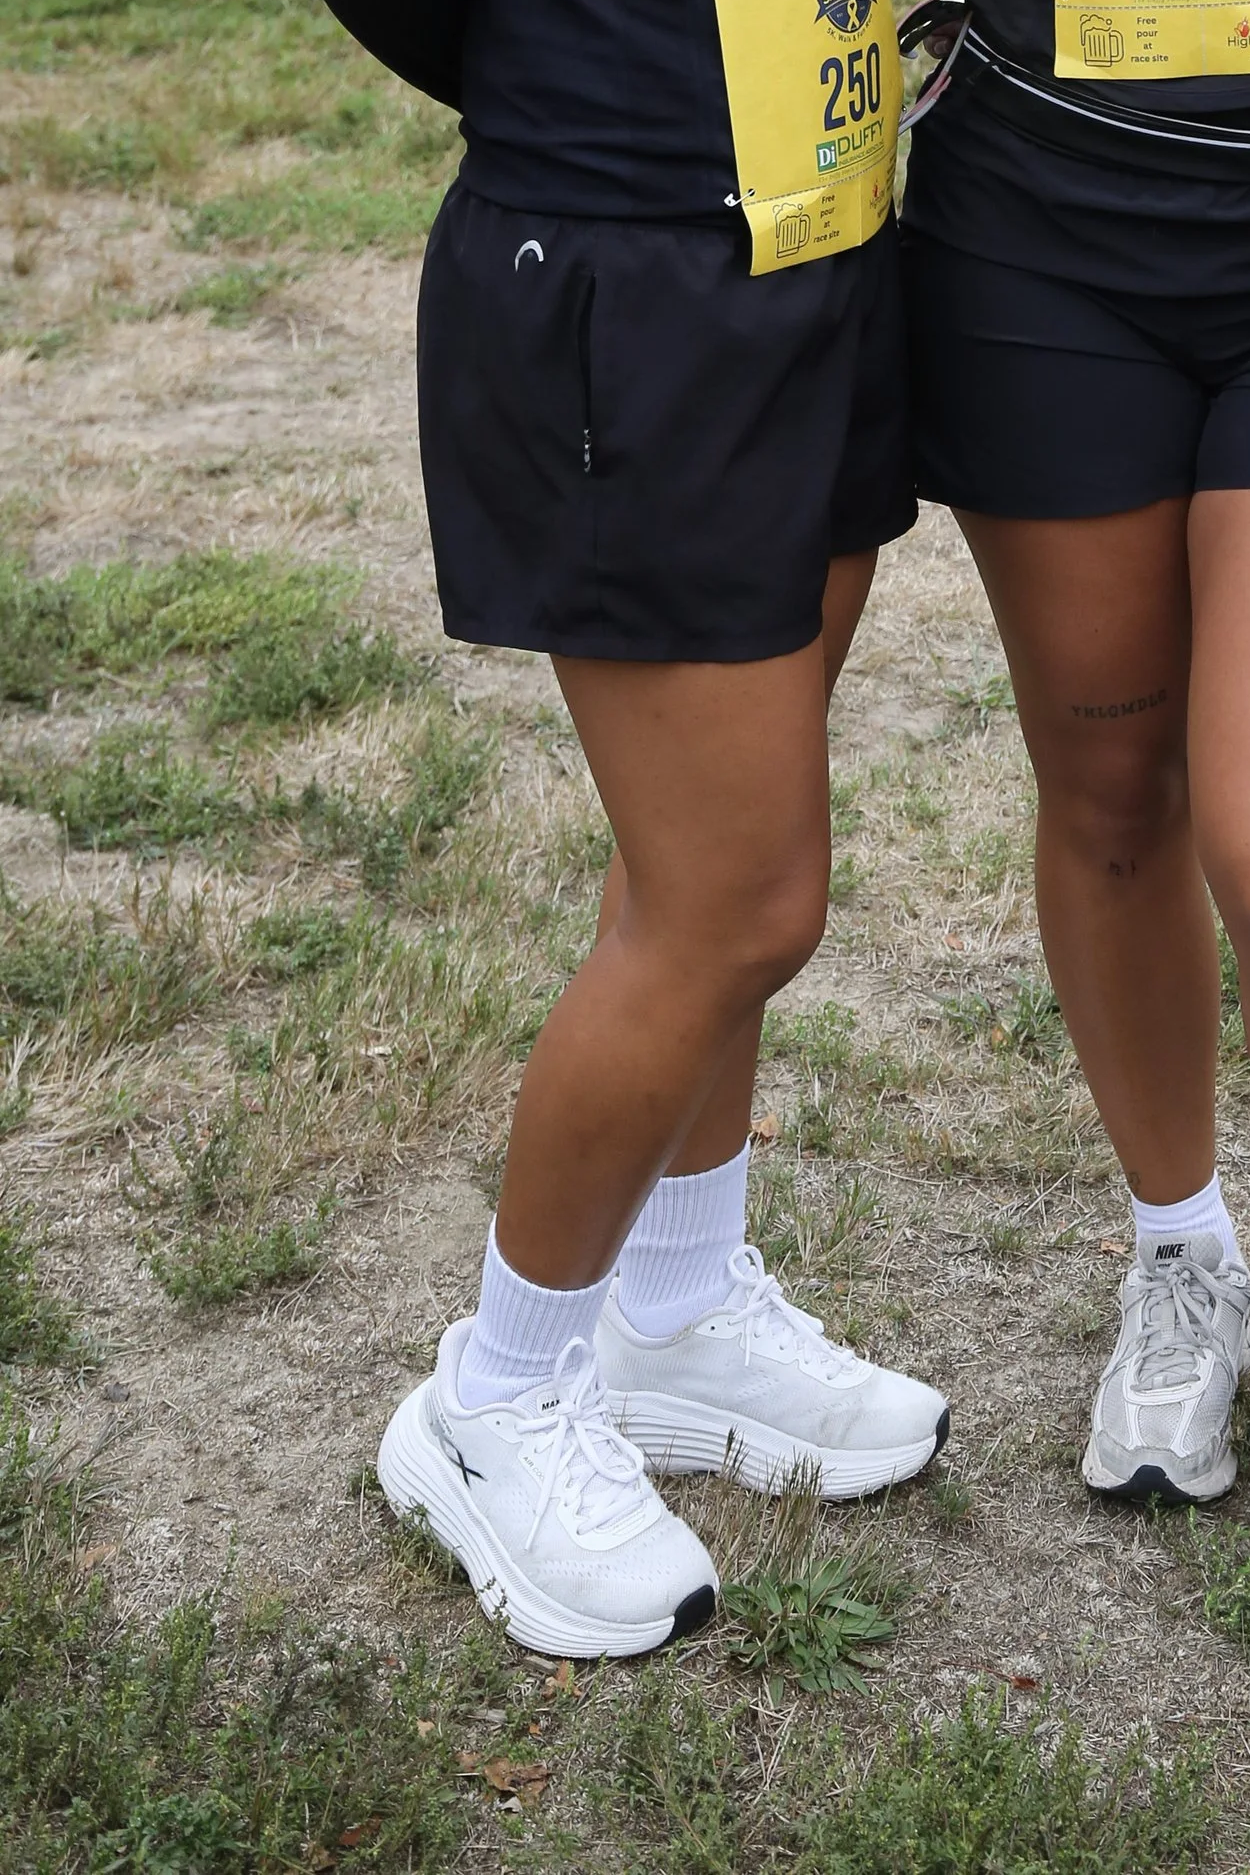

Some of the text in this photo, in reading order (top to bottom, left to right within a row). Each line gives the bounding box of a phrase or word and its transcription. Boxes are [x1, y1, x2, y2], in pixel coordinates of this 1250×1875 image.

[1136, 17, 1157, 25] Free
[1136, 30, 1158, 40] pour
[1143, 42, 1153, 50] at
[1152, 54, 1169, 62] site
[819, 42, 881, 132] 250
[817, 145, 837, 167] Di
[837, 116, 885, 157] DUFFY
[821, 194, 835, 204] Free
[820, 207, 835, 219] pour
[823, 220, 831, 228] at
[813, 230, 840, 243] race site
[1155, 1243, 1186, 1260] NIKE
